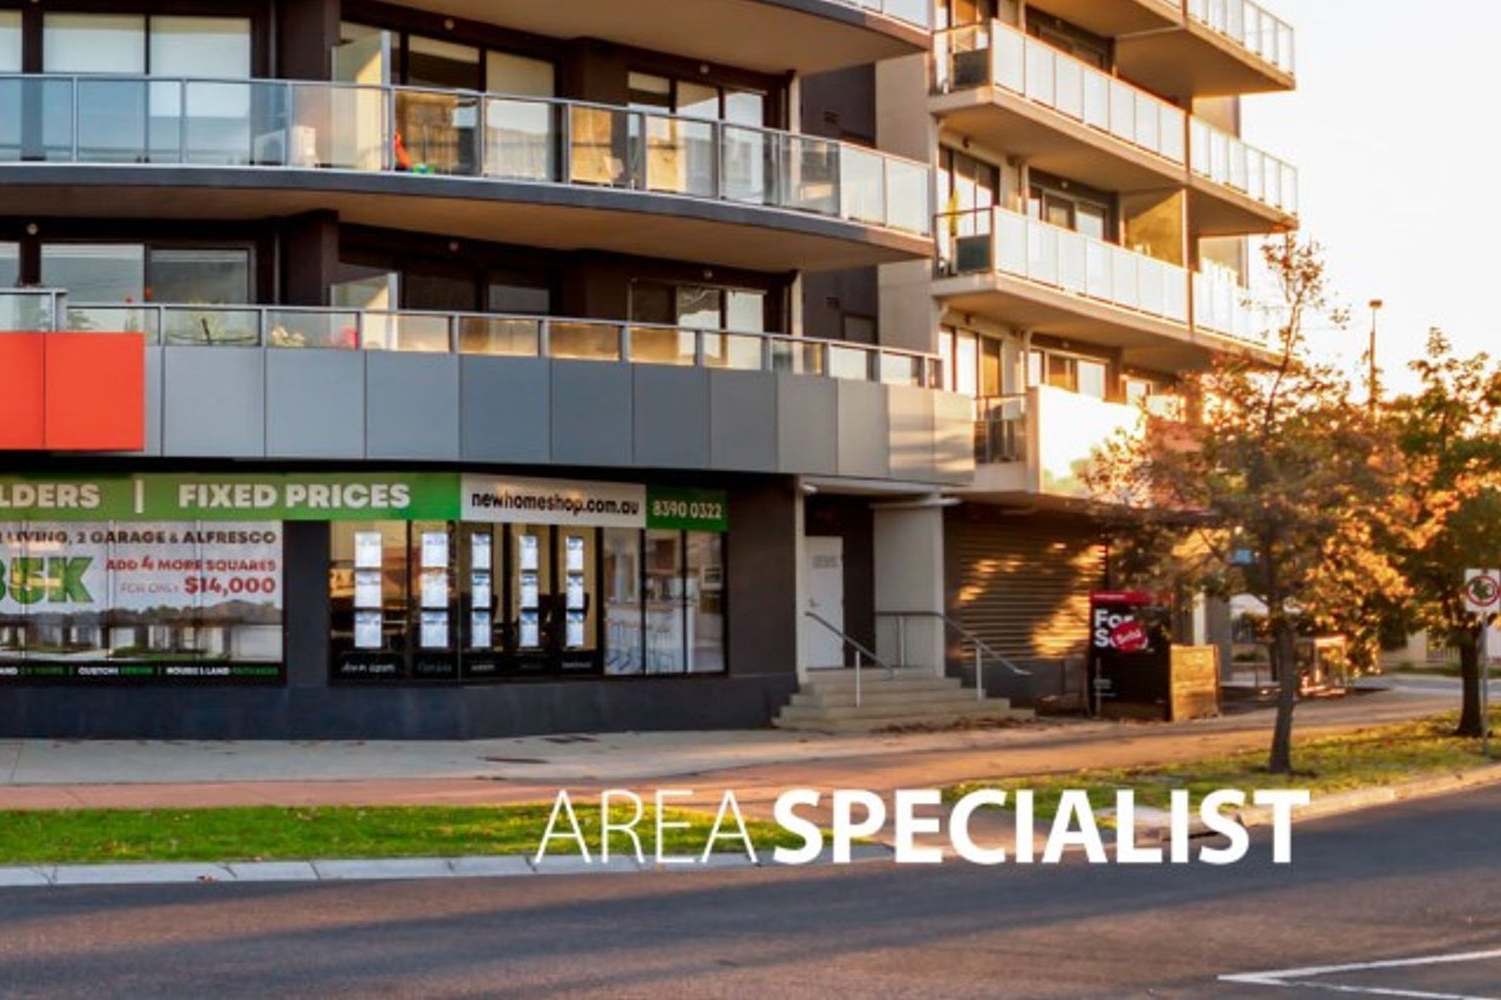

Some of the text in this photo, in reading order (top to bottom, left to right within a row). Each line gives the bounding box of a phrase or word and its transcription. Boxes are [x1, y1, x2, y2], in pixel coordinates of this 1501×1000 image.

[178, 484, 278, 508] FIXED
[285, 484, 411, 508] PRICES
[471, 491, 722, 520] newhomeshop.com.au 8390 0322
[77, 532, 86, 544] 2
[91, 531, 165, 544] GARAGE
[183, 531, 277, 544] ALFRESCO
[106, 555, 276, 571] ADD 4 MORE SQUARES
[185, 576, 276, 597] $14,000
